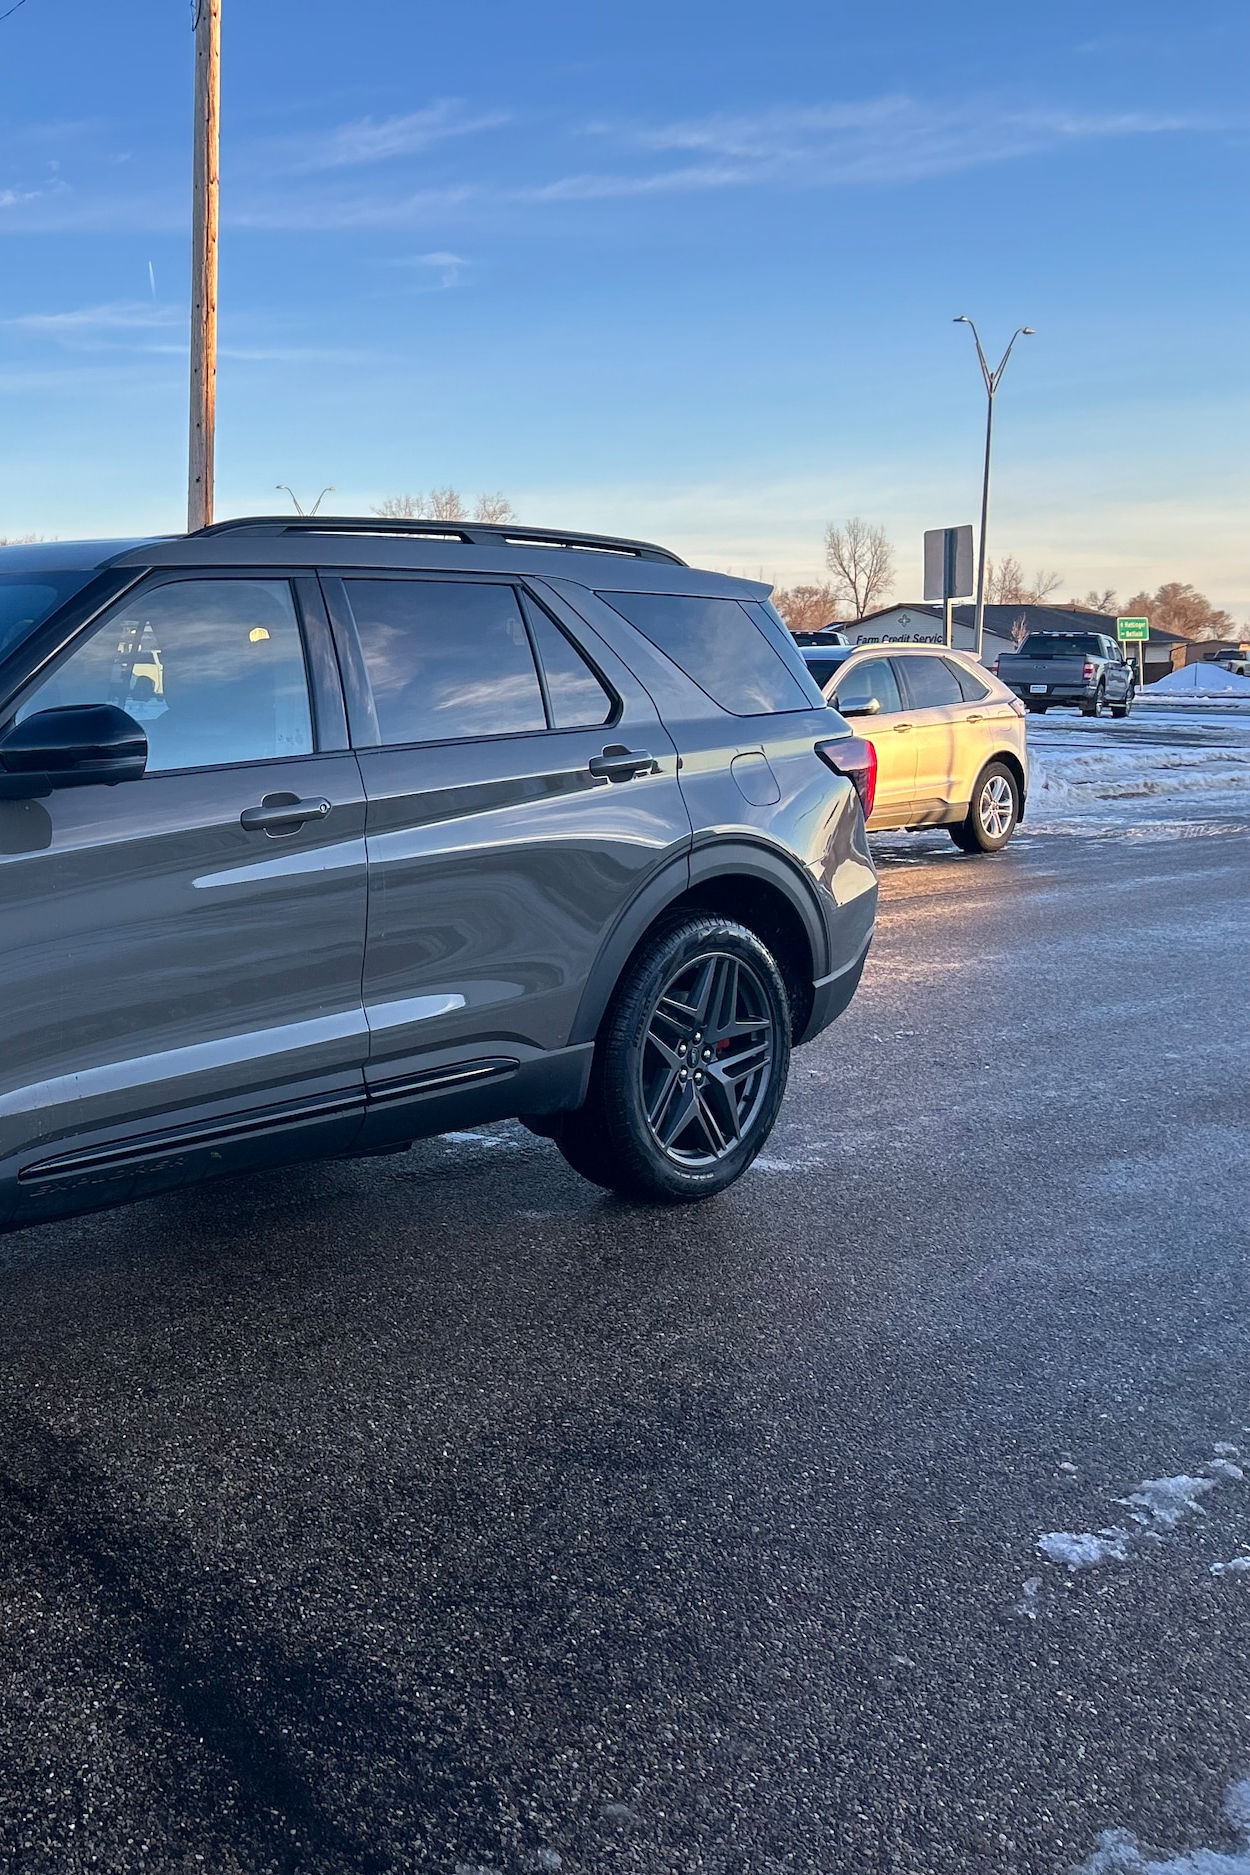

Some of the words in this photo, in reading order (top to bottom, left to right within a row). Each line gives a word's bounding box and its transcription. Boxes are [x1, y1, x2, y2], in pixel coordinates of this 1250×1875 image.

[856, 634, 880, 645] Farm
[882, 634, 911, 644] Credit
[912, 633, 954, 643] Servic
[30, 1157, 185, 1198] EXPLORER
